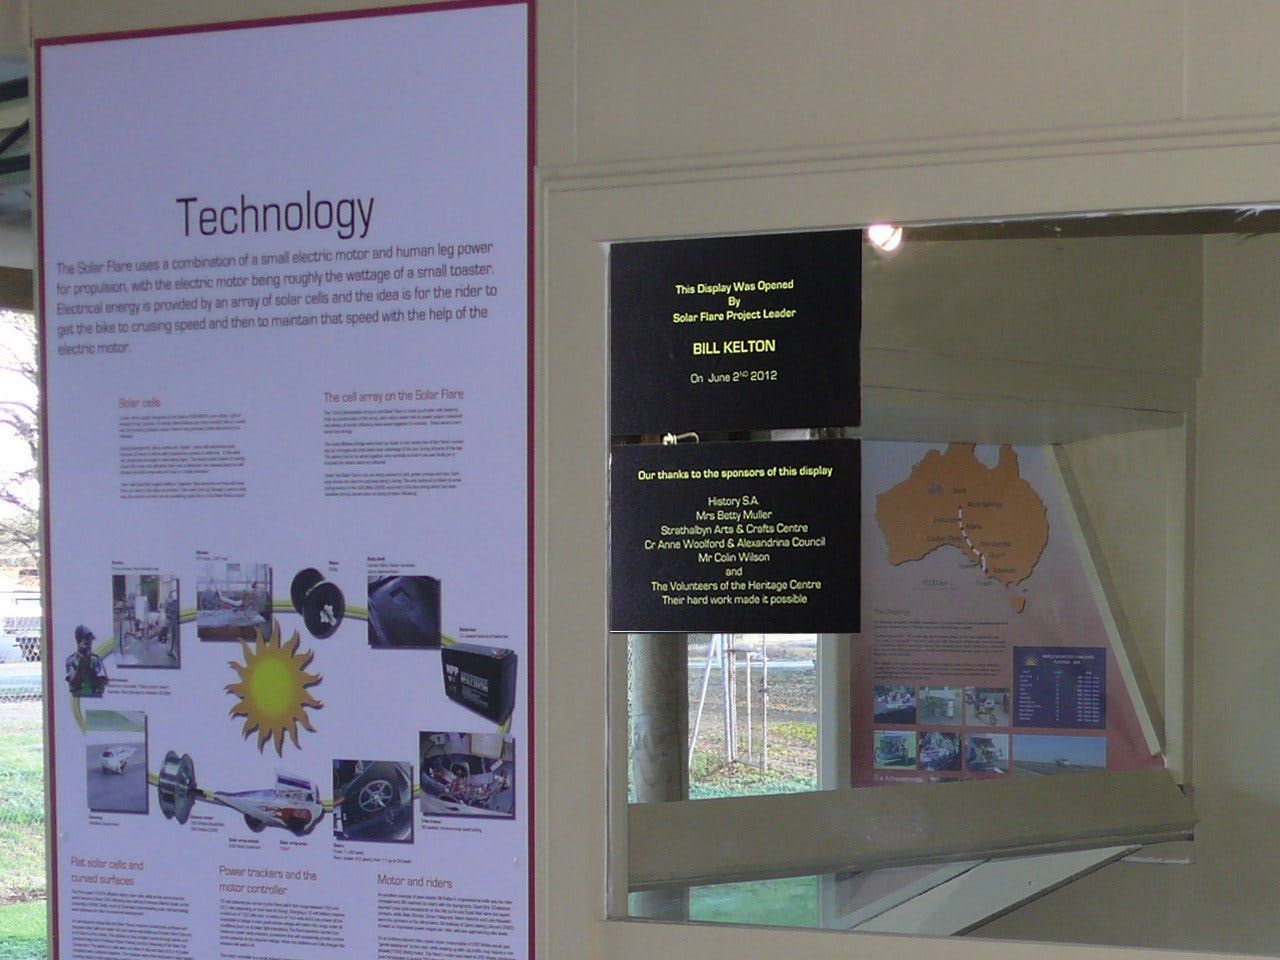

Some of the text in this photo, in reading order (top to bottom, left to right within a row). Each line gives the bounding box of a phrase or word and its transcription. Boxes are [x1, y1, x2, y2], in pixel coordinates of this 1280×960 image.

[176, 191, 374, 239] Technology
[57, 243, 493, 274] The Solar Flare uses a combination of a small electric motor and human leg power
[57, 283, 71, 295] for
[132, 280, 151, 292] with
[155, 279, 172, 290] the
[175, 277, 212, 289] electric
[216, 276, 248, 287] motor
[252, 274, 280, 288] being
[284, 271, 323, 288] roughly
[326, 270, 342, 282] the
[346, 270, 390, 283] wattage
[394, 267, 404, 279] of
[407, 268, 413, 278] a
[418, 264, 447, 277] small
[676, 279, 794, 294] This Display Was Opened
[57, 285, 497, 316] Electrical energy is provided by an array of solar cells and the idea is for the rider to
[728, 297, 740, 307] By
[673, 308, 796, 323] Solar Flare Project Leader
[693, 340, 776, 354] BILL KELTON
[690, 373, 703, 383] On
[708, 373, 730, 383] June
[750, 371, 777, 380] 2012
[324, 392, 338, 402] The
[342, 391, 357, 402] cell
[359, 392, 383, 403] array
[398, 391, 413, 400] the
[415, 390, 439, 400] Solar
[441, 389, 464, 399] Flare
[638, 466, 833, 480] Our thanks to the sponsors of this display
[708, 497, 740, 507] History
[697, 511, 773, 521] Mrs Betty Muller
[661, 523, 808, 536] Strathalbyn Arts & Crafts Centre
[645, 537, 826, 549] Cr Anne Woolford & Alexandrina Council
[699, 552, 770, 562] Mr Colin Wilson
[726, 567, 743, 576] and
[651, 580, 821, 591] The Volunteers of the Heritage Centre
[662, 594, 807, 605] Their hard work made it possible
[219, 865, 317, 880] Power trackers and the
[378, 875, 452, 888] Motor and riders
[219, 884, 288, 895] motor controller
